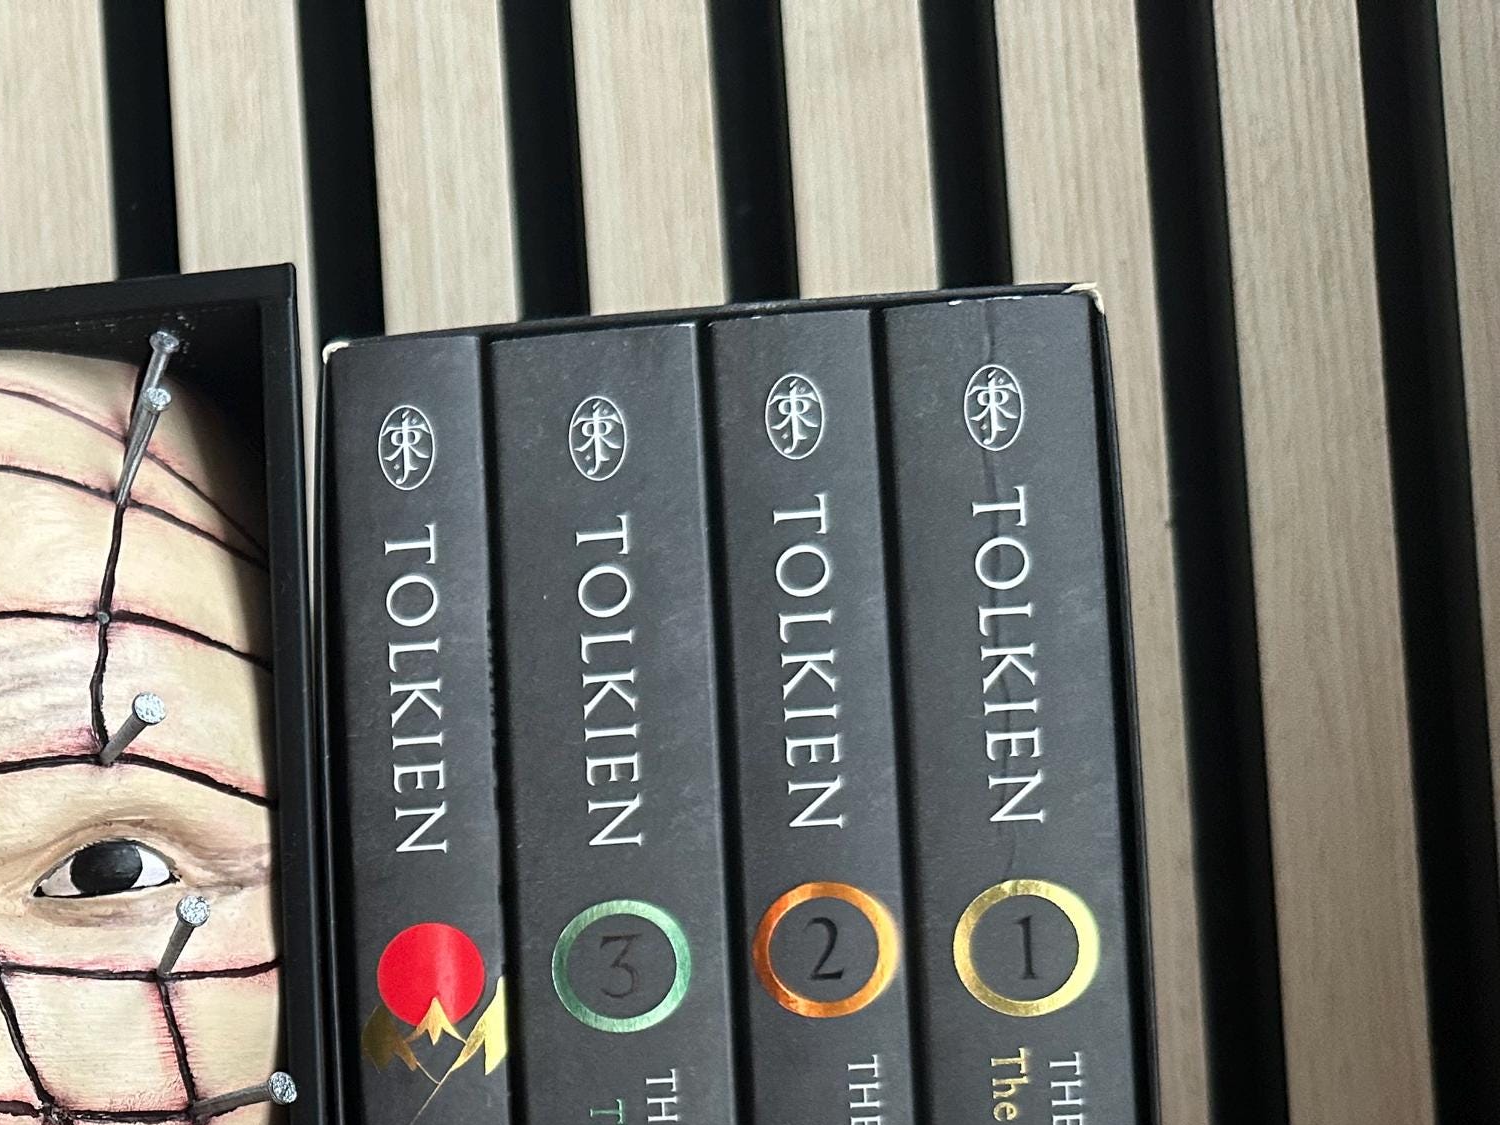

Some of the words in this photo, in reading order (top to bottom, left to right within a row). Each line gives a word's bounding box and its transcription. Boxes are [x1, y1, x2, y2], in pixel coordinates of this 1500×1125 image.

[383, 523, 448, 854] TOLKIEN
[575, 514, 644, 848] TOLKIEN
[772, 493, 844, 830] TOLKIEN
[971, 486, 1046, 825] TOLKIEN
[600, 932, 641, 999] 3
[804, 915, 845, 981] 2
[1015, 915, 1041, 981] 1
[990, 1047, 1029, 1122] The
